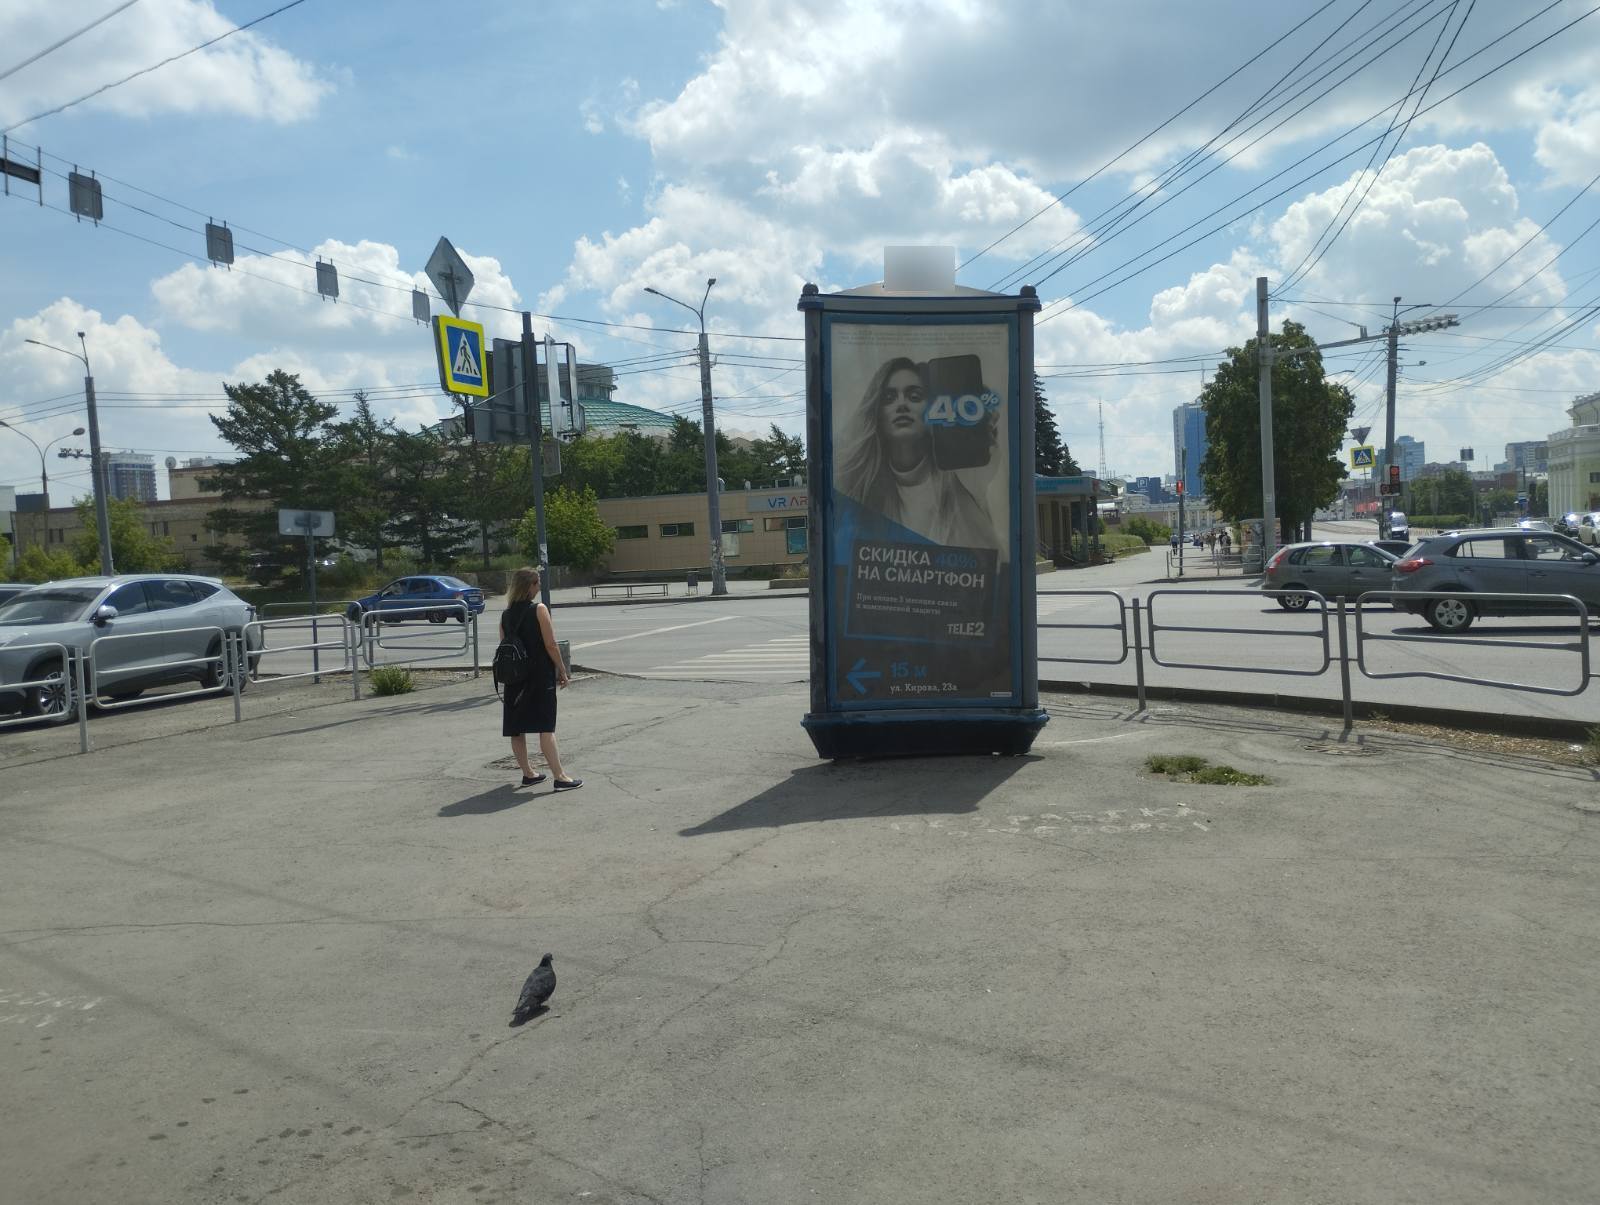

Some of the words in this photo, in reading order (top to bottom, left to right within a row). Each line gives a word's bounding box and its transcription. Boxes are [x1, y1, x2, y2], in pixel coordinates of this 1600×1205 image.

[926, 391, 999, 425] 40%
[768, 497, 786, 508] VR
[859, 546, 931, 566] СКИДКА
[857, 565, 880, 581] НА
[885, 567, 985, 588] СМАРТФОН
[947, 622, 985, 636] TELE2
[890, 662, 909, 678] 15
[905, 683, 940, 694] Кирова,
